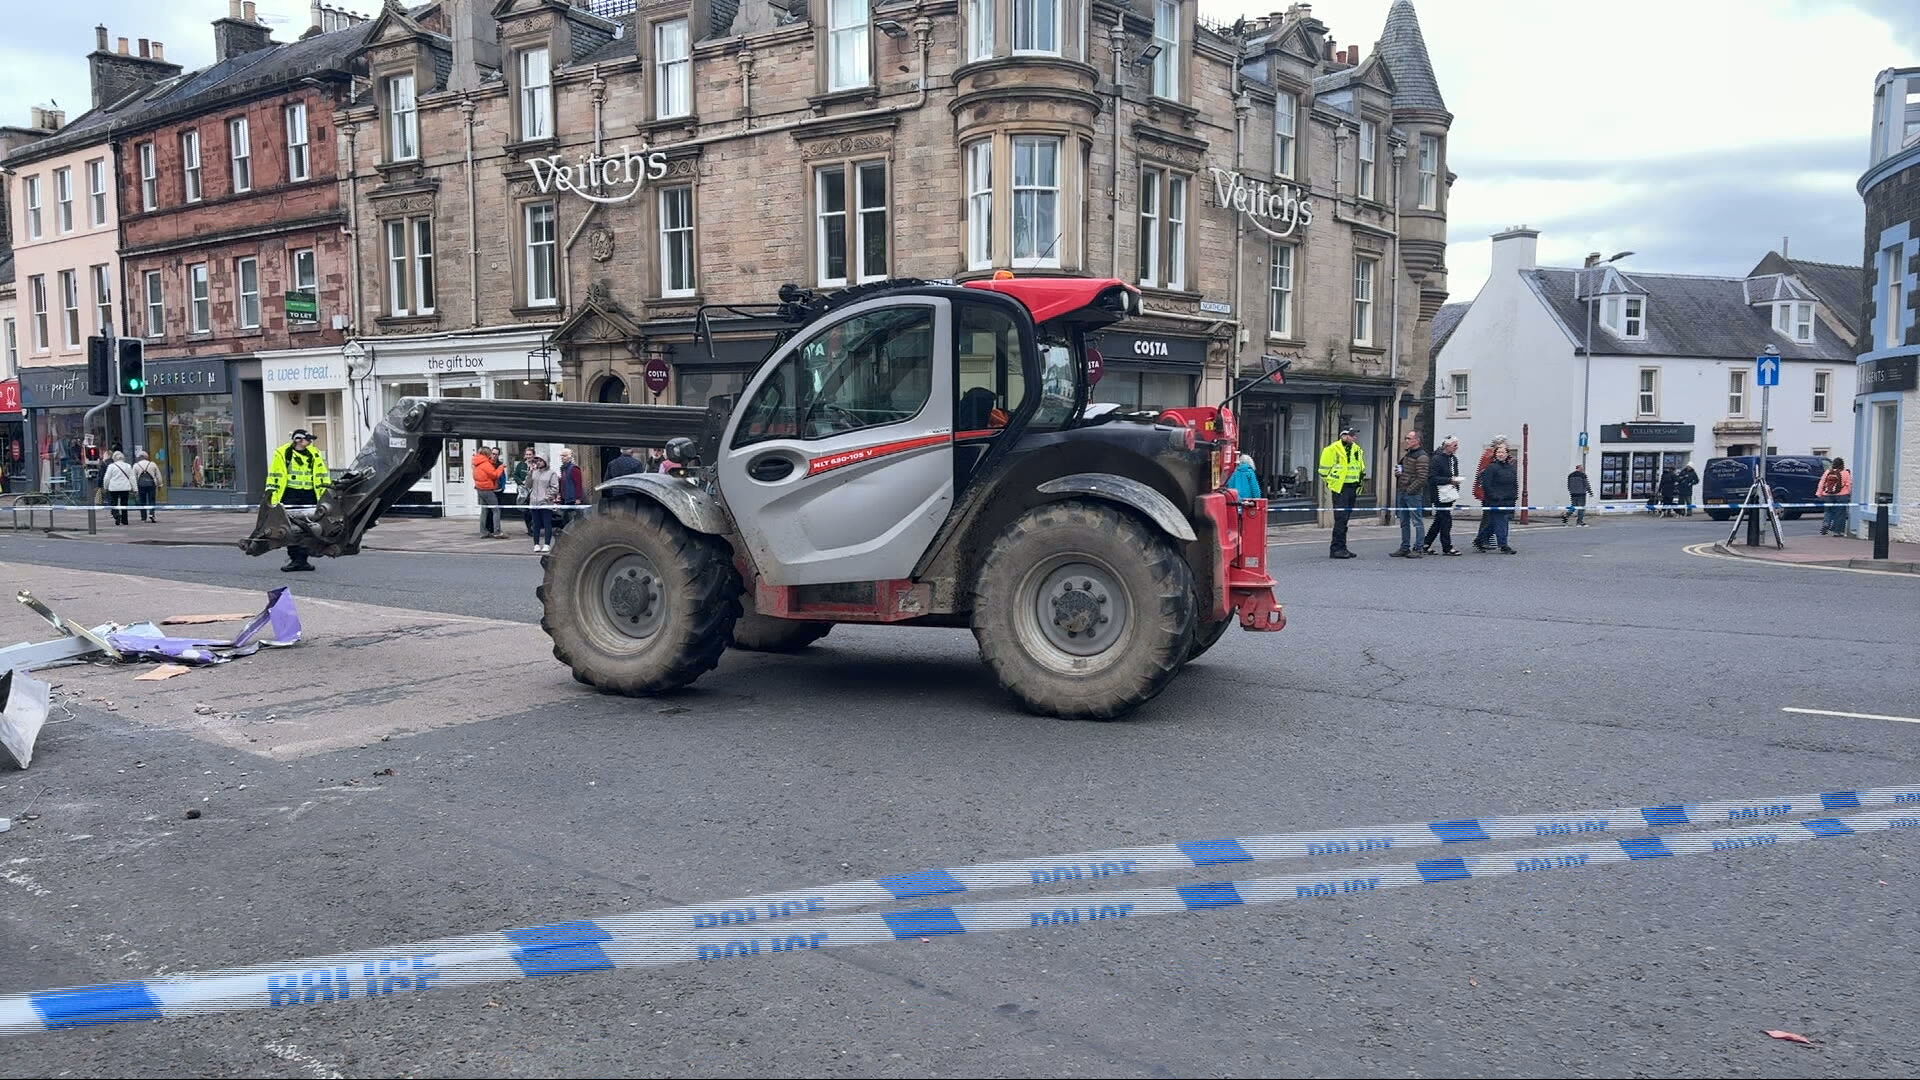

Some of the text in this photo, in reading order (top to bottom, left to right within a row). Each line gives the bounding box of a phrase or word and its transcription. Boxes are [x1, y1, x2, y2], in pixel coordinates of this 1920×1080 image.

[525, 144, 667, 203] Veitch's
[1209, 168, 1313, 237] Veitch's
[1134, 341, 1168, 356] COSTA
[428, 355, 483, 371] the gift box
[1088, 361, 1099, 369] STA
[153, 371, 202, 386] PERFECT
[267, 369, 274, 381] a
[278, 368, 300, 381] wee
[50, 371, 79, 400] perfect
[814, 460, 831, 469] MLT
